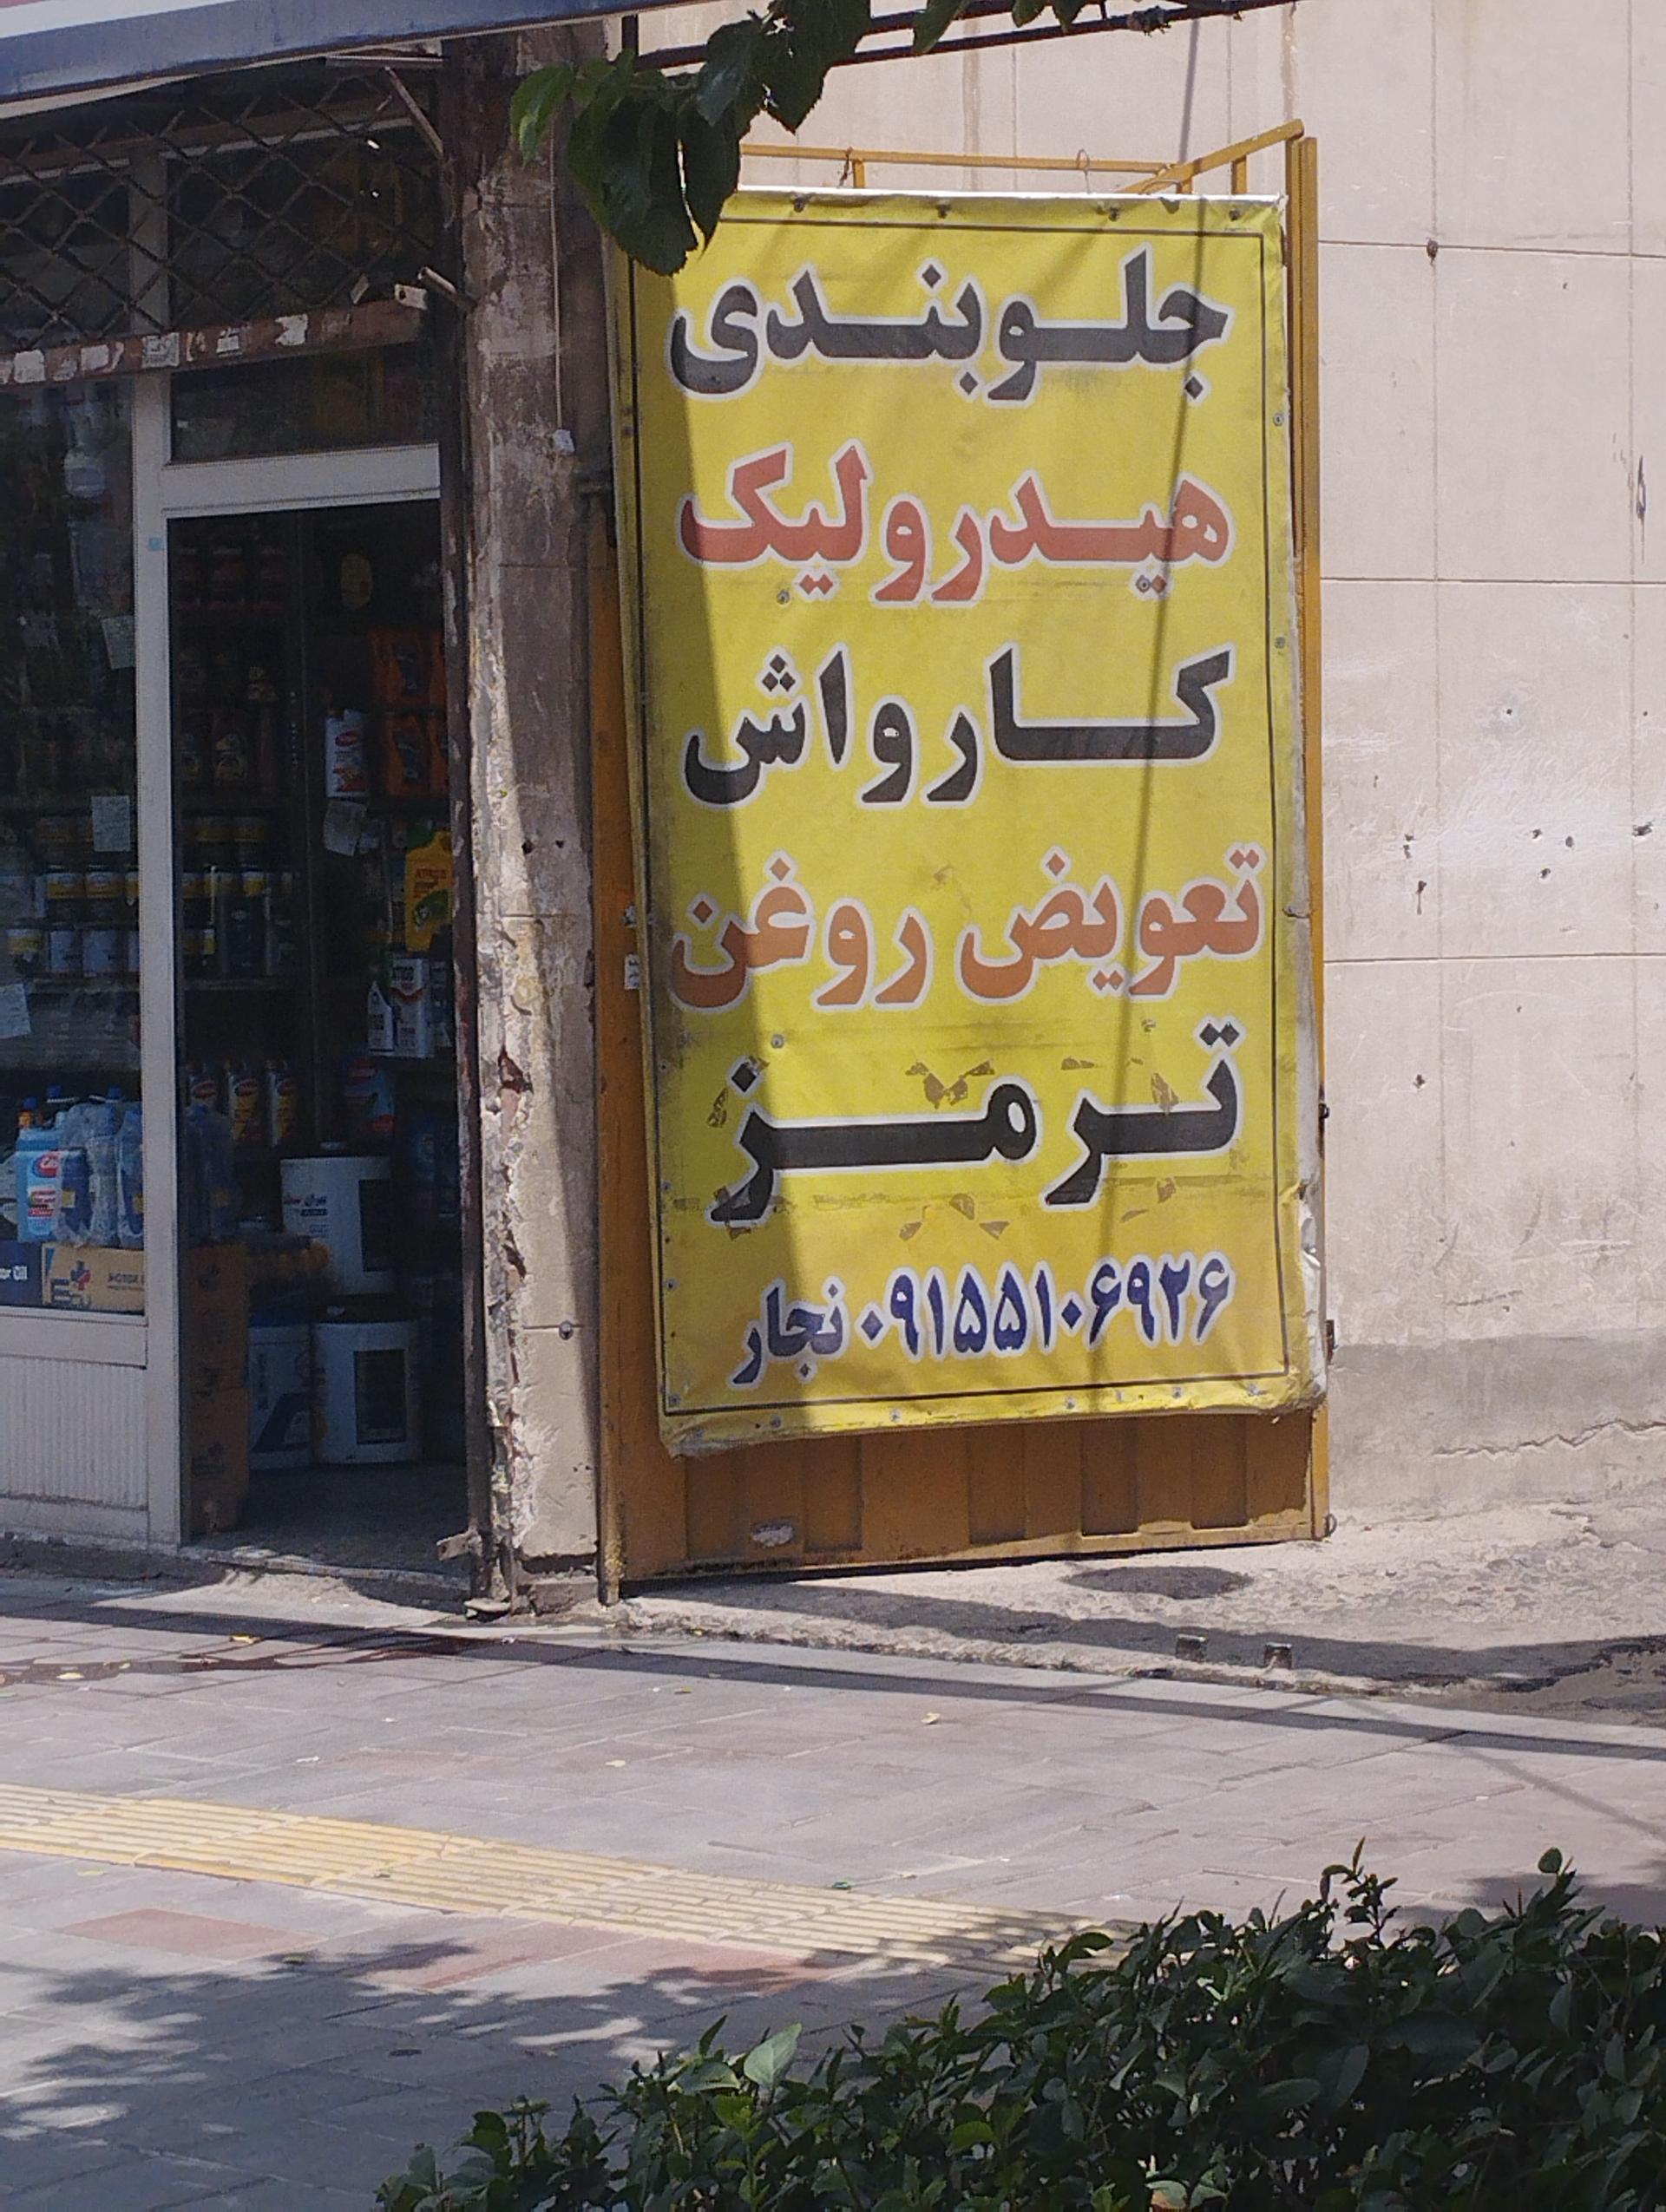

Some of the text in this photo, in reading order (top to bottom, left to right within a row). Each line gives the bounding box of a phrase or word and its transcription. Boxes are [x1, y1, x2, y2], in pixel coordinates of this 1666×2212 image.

[670, 248, 1230, 402] جلوبندی
[679, 444, 1231, 603] هیدرولیک
[684, 646, 1232, 805] کارواش
[671, 847, 1262, 1009] تعویض روغن
[708, 1021, 1241, 1221] ترمز
[732, 1257, 1230, 1385] ۰۹۱۵۵۱۰۶۹۲۶ نجار
